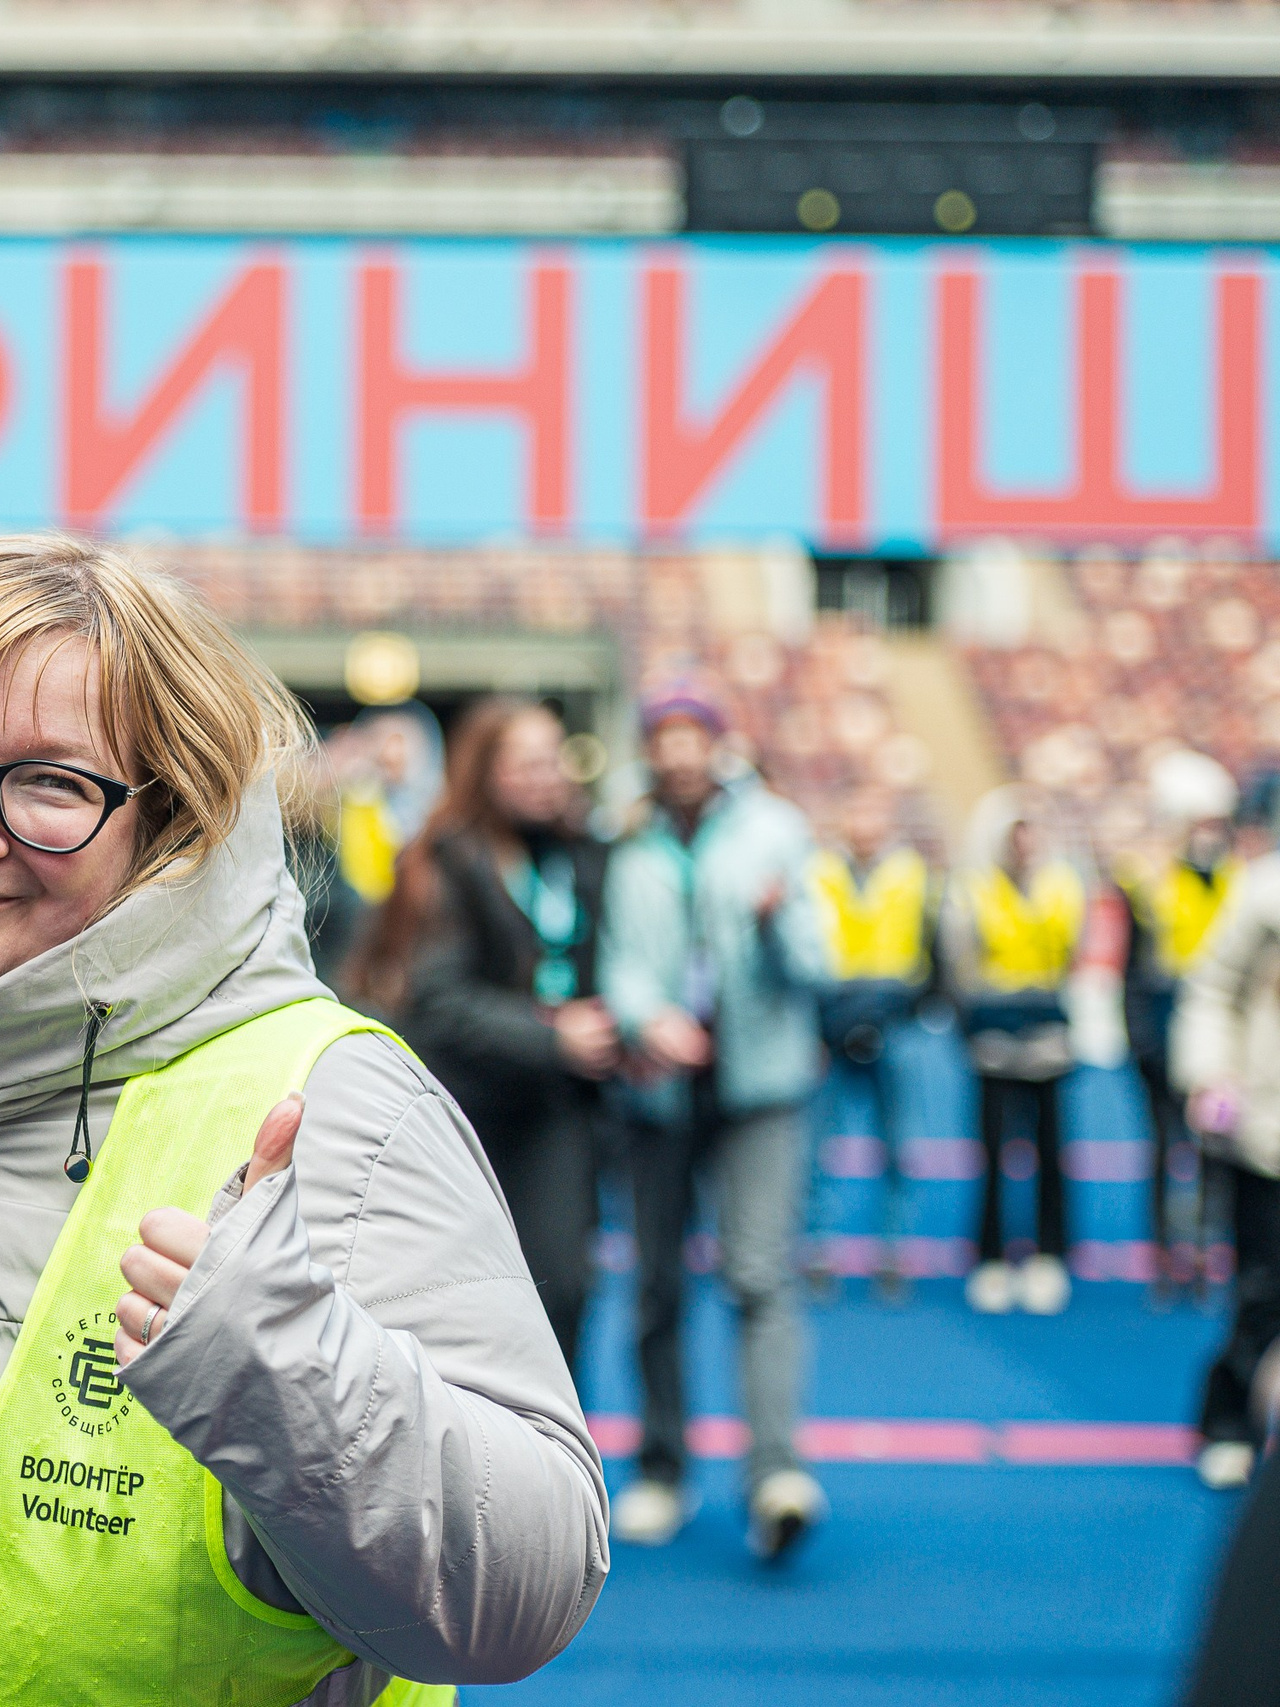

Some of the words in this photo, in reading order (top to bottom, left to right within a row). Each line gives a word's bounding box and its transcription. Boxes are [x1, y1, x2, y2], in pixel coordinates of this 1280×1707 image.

[52, 1378, 134, 1437] СООБЩЕСТВО
[20, 1455, 144, 1496] ВОЛОНТЁР
[22, 1493, 136, 1536] Volunteer
